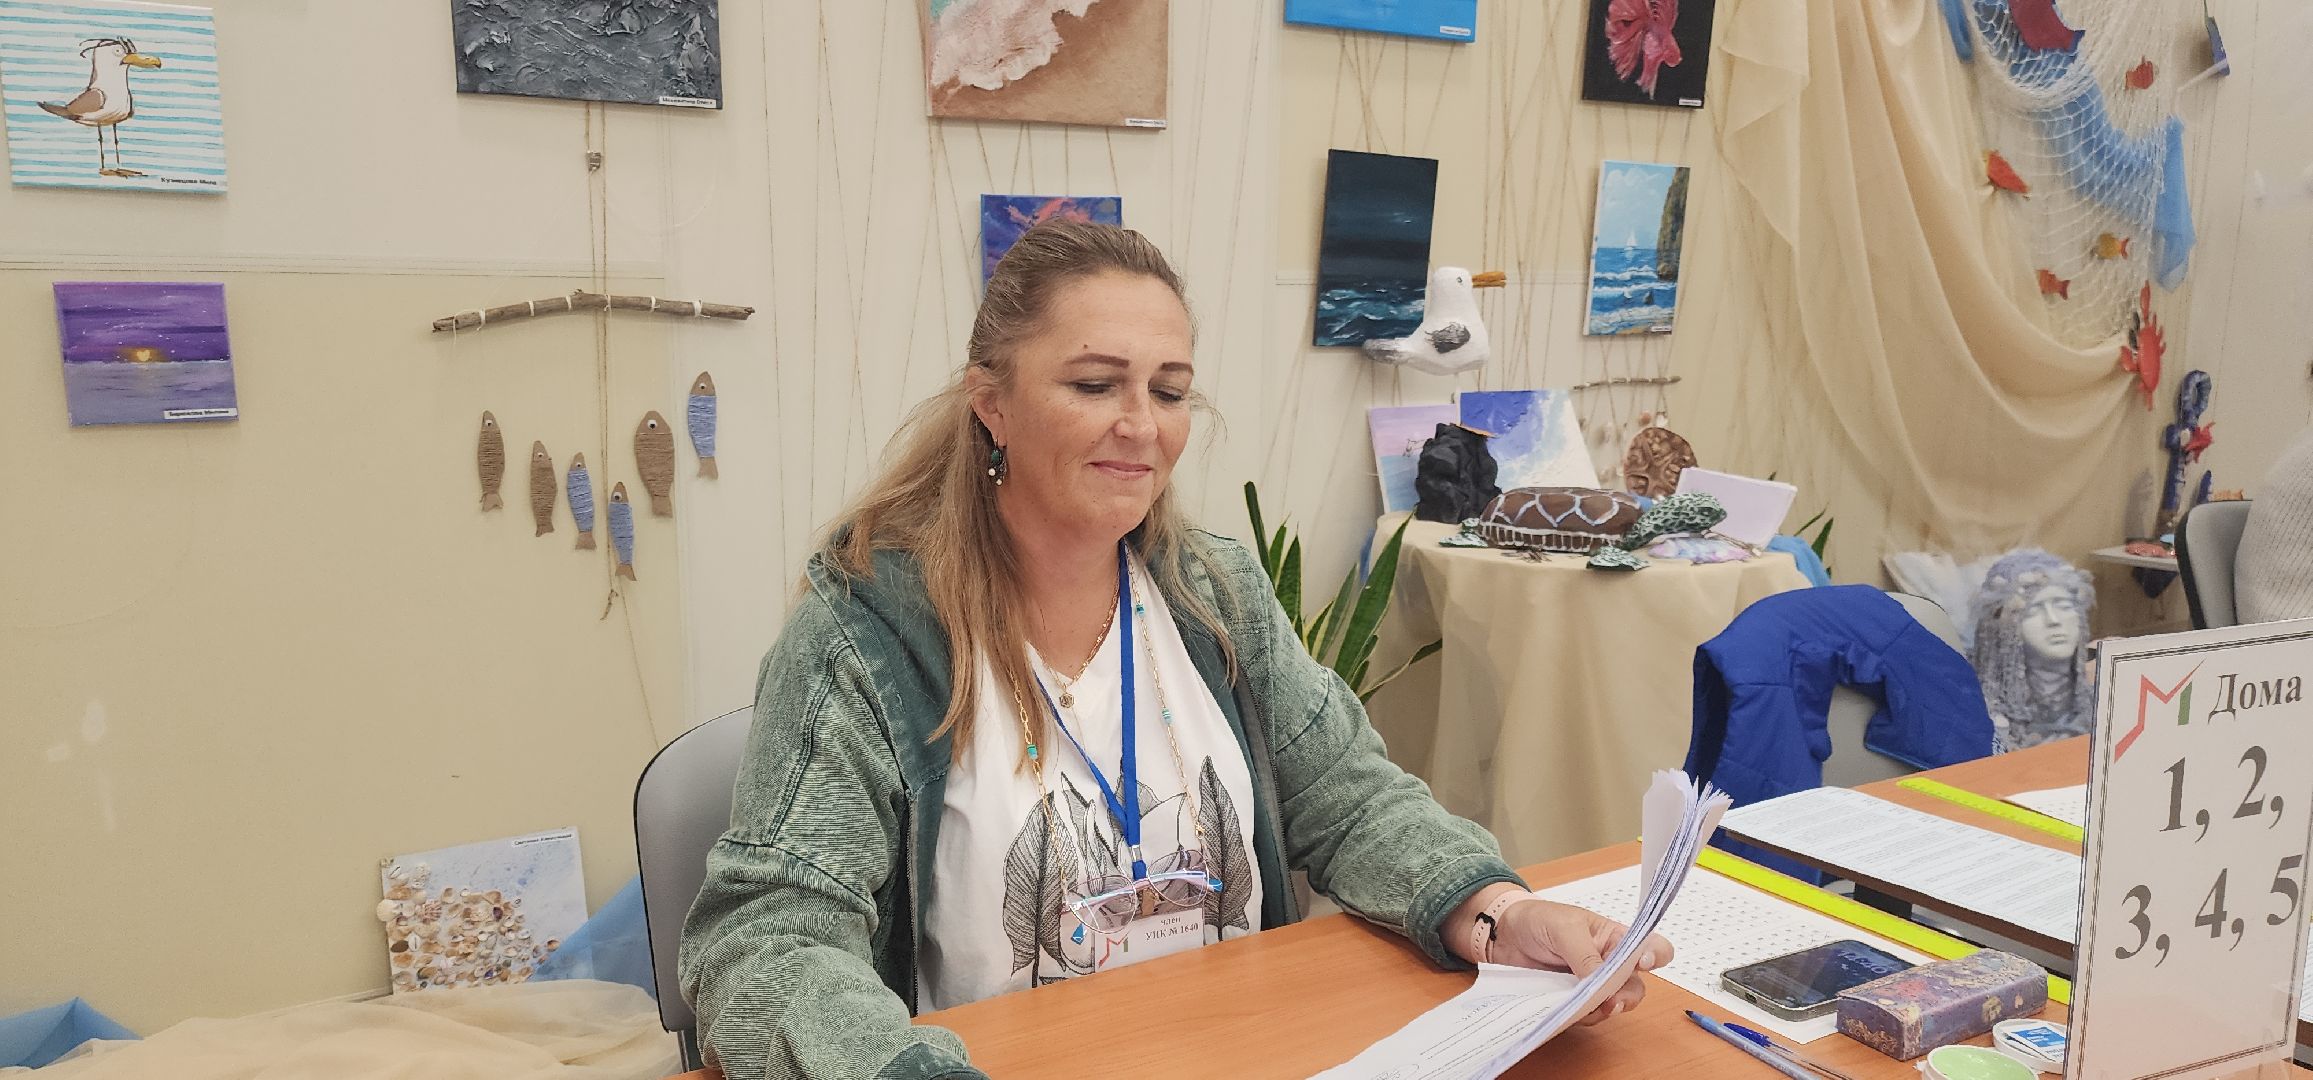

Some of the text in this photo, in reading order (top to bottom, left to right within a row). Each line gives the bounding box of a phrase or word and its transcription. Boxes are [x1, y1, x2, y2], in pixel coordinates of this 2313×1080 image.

[2207, 673, 2303, 725] Дома
[2159, 745, 2284, 844] 1, 2,
[1145, 929, 1167, 941] УИК
[2115, 854, 2303, 968] 3, 4, 5
